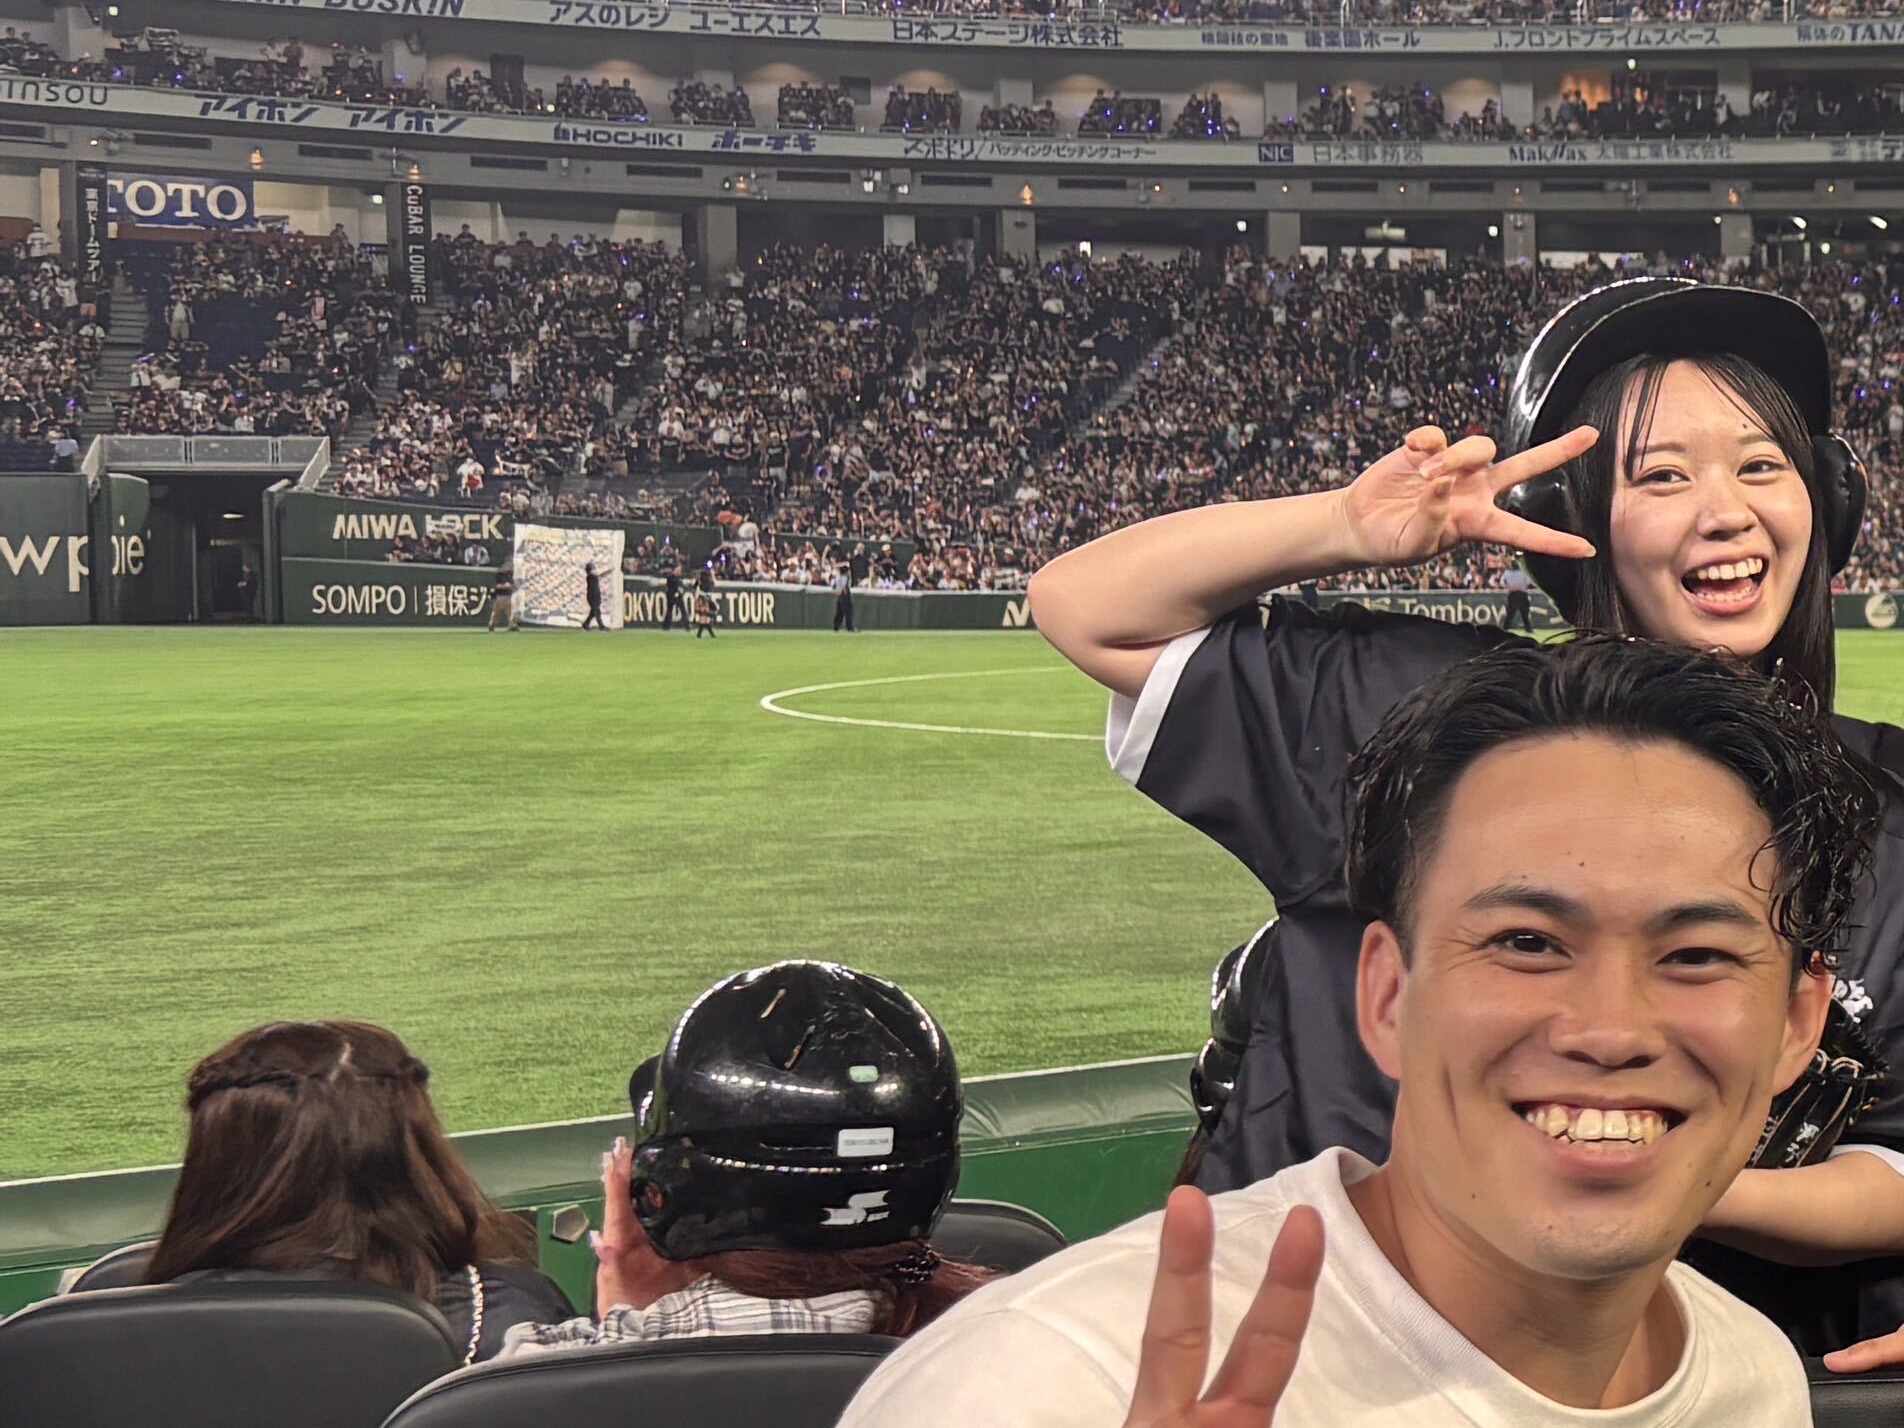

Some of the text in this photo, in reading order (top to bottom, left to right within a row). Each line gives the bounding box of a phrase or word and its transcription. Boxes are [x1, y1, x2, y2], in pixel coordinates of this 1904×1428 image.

[893, 21, 1125, 47] 日本ステージ株式会社
[199, 93, 470, 132] アイホン アイホン
[572, 129, 817, 152] HOCHIKI ホーチキ
[409, 245, 426, 305] LOUNGE
[333, 514, 416, 540] MIWA
[312, 584, 495, 616] SOMPO 損保ジ
[623, 592, 668, 622] OKYO
[726, 592, 775, 623] TOUR
